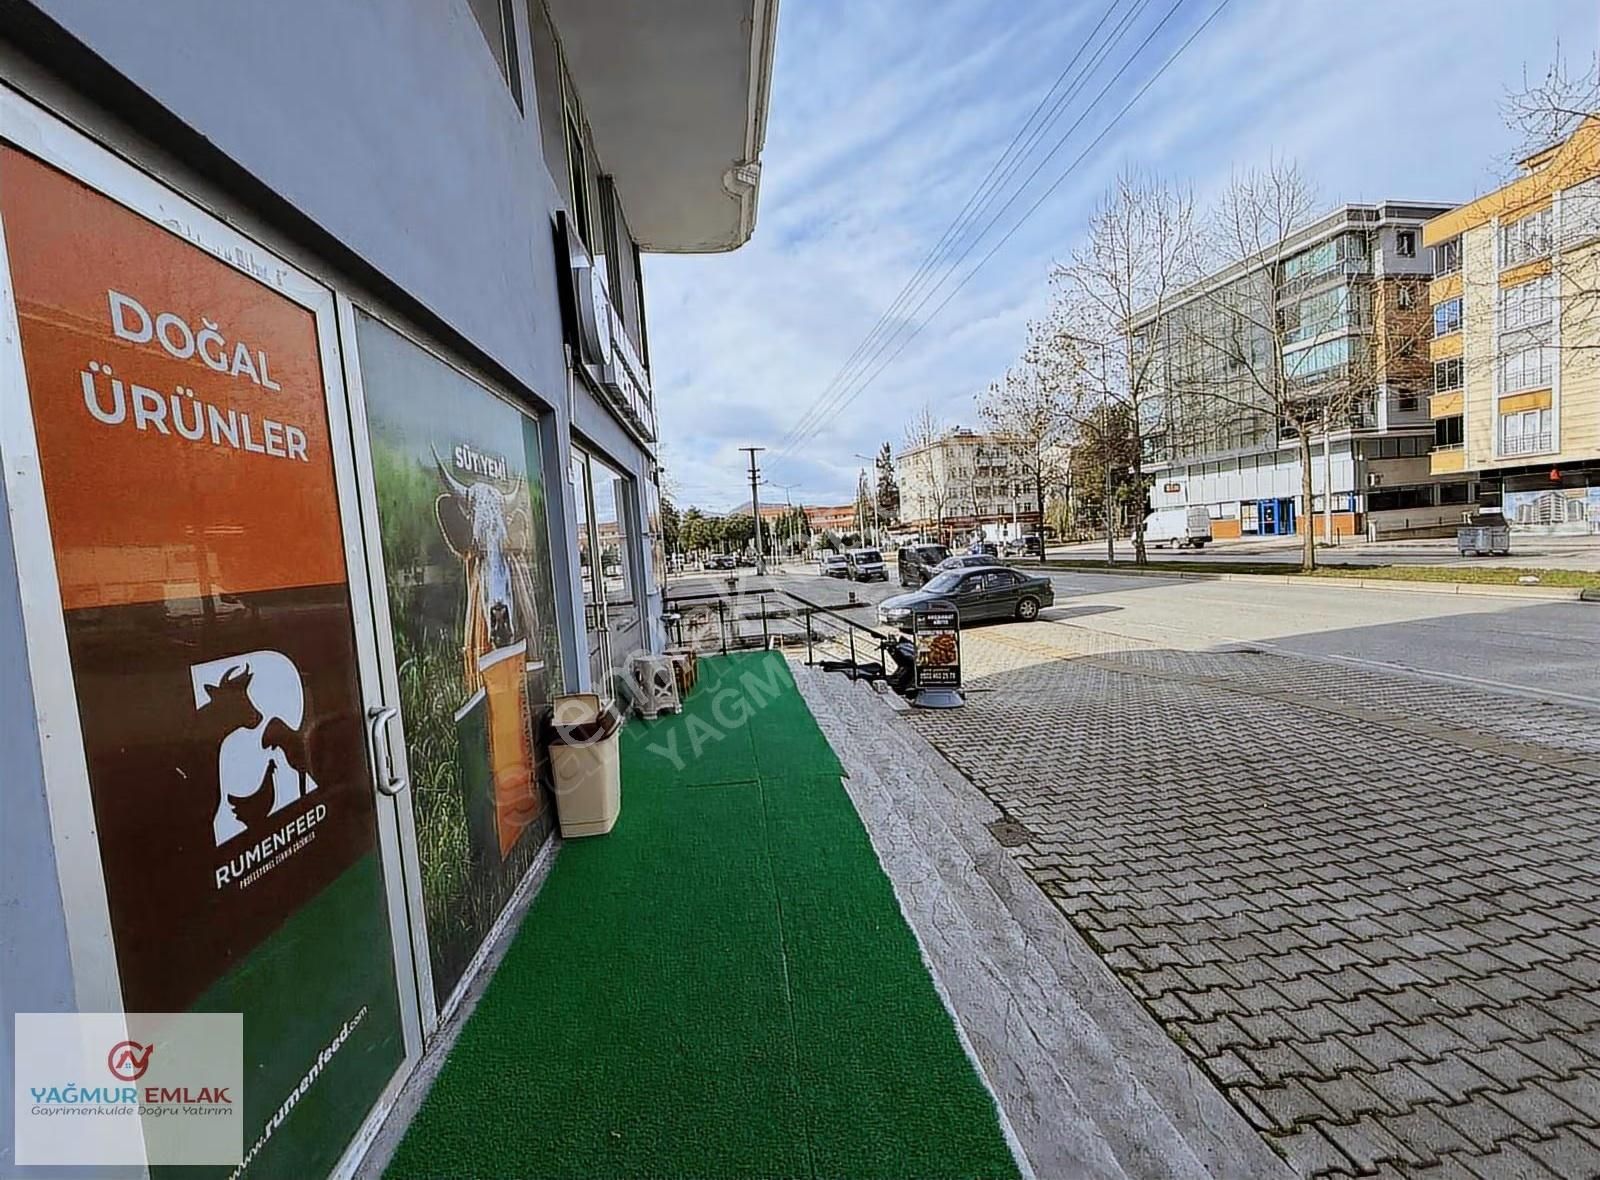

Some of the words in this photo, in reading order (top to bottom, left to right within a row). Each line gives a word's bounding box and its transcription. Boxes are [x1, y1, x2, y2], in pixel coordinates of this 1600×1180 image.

[107, 288, 282, 392] DOĞAL
[80, 360, 309, 463] ÜRÜNLER
[215, 803, 327, 889] RUMENFEED
